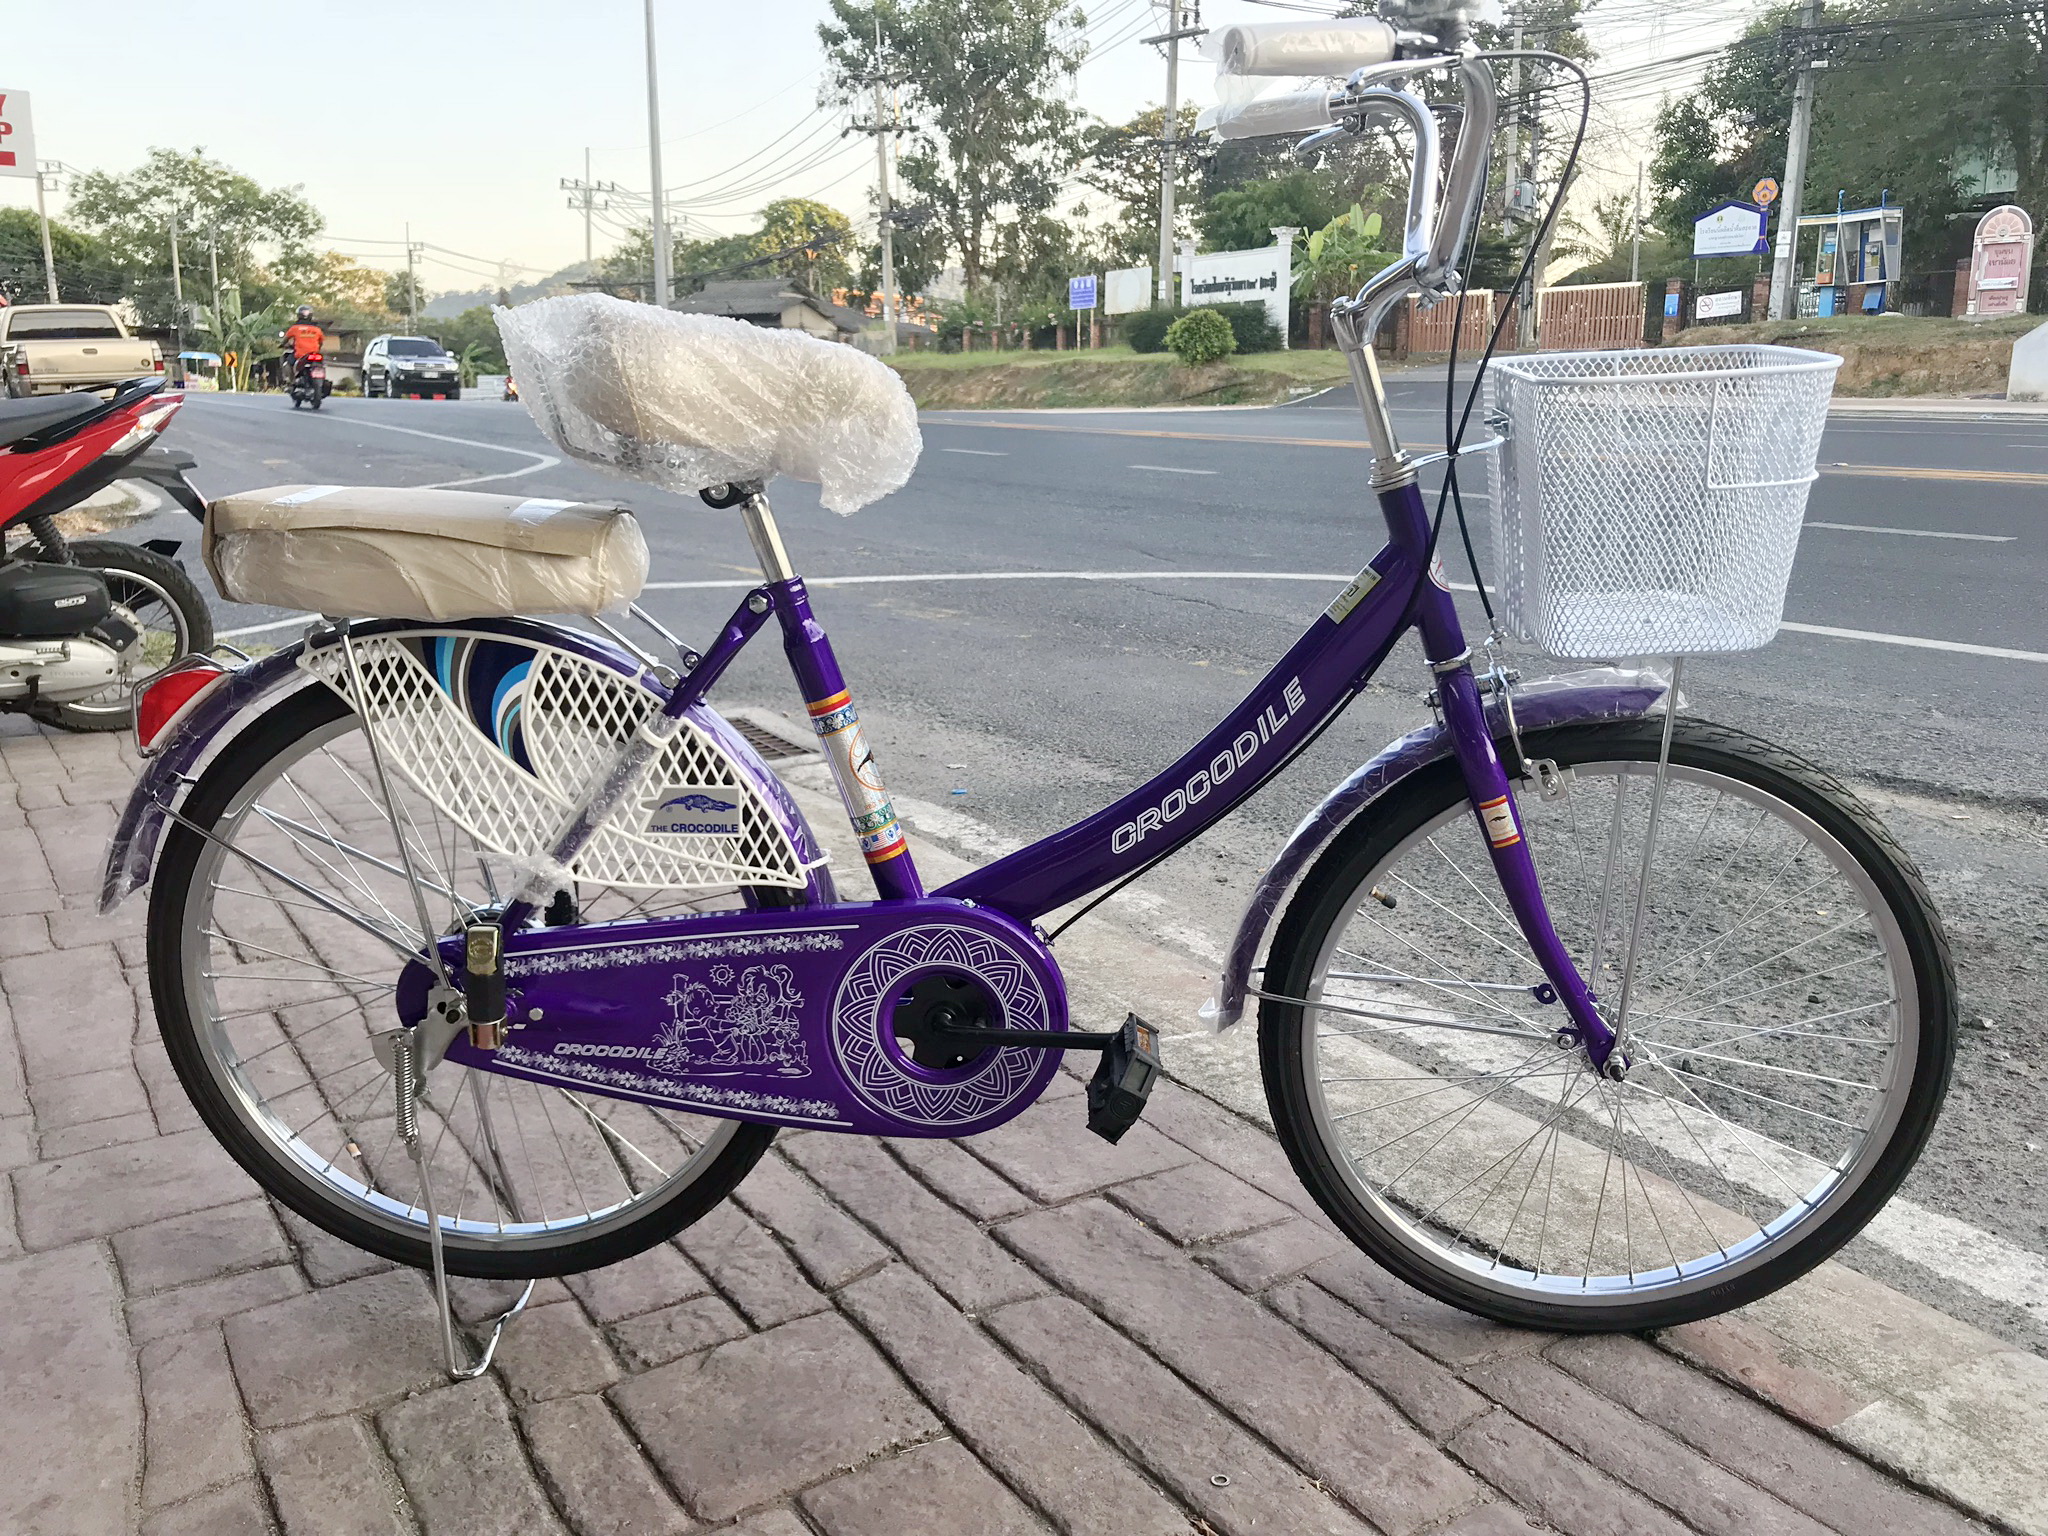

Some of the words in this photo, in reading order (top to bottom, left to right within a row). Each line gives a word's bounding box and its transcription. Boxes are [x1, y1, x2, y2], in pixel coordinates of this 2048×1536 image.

[1111, 676, 1306, 854] CROCODILE
[671, 823, 739, 833] CROCODILE
[554, 1043, 668, 1060] CROCODILE
